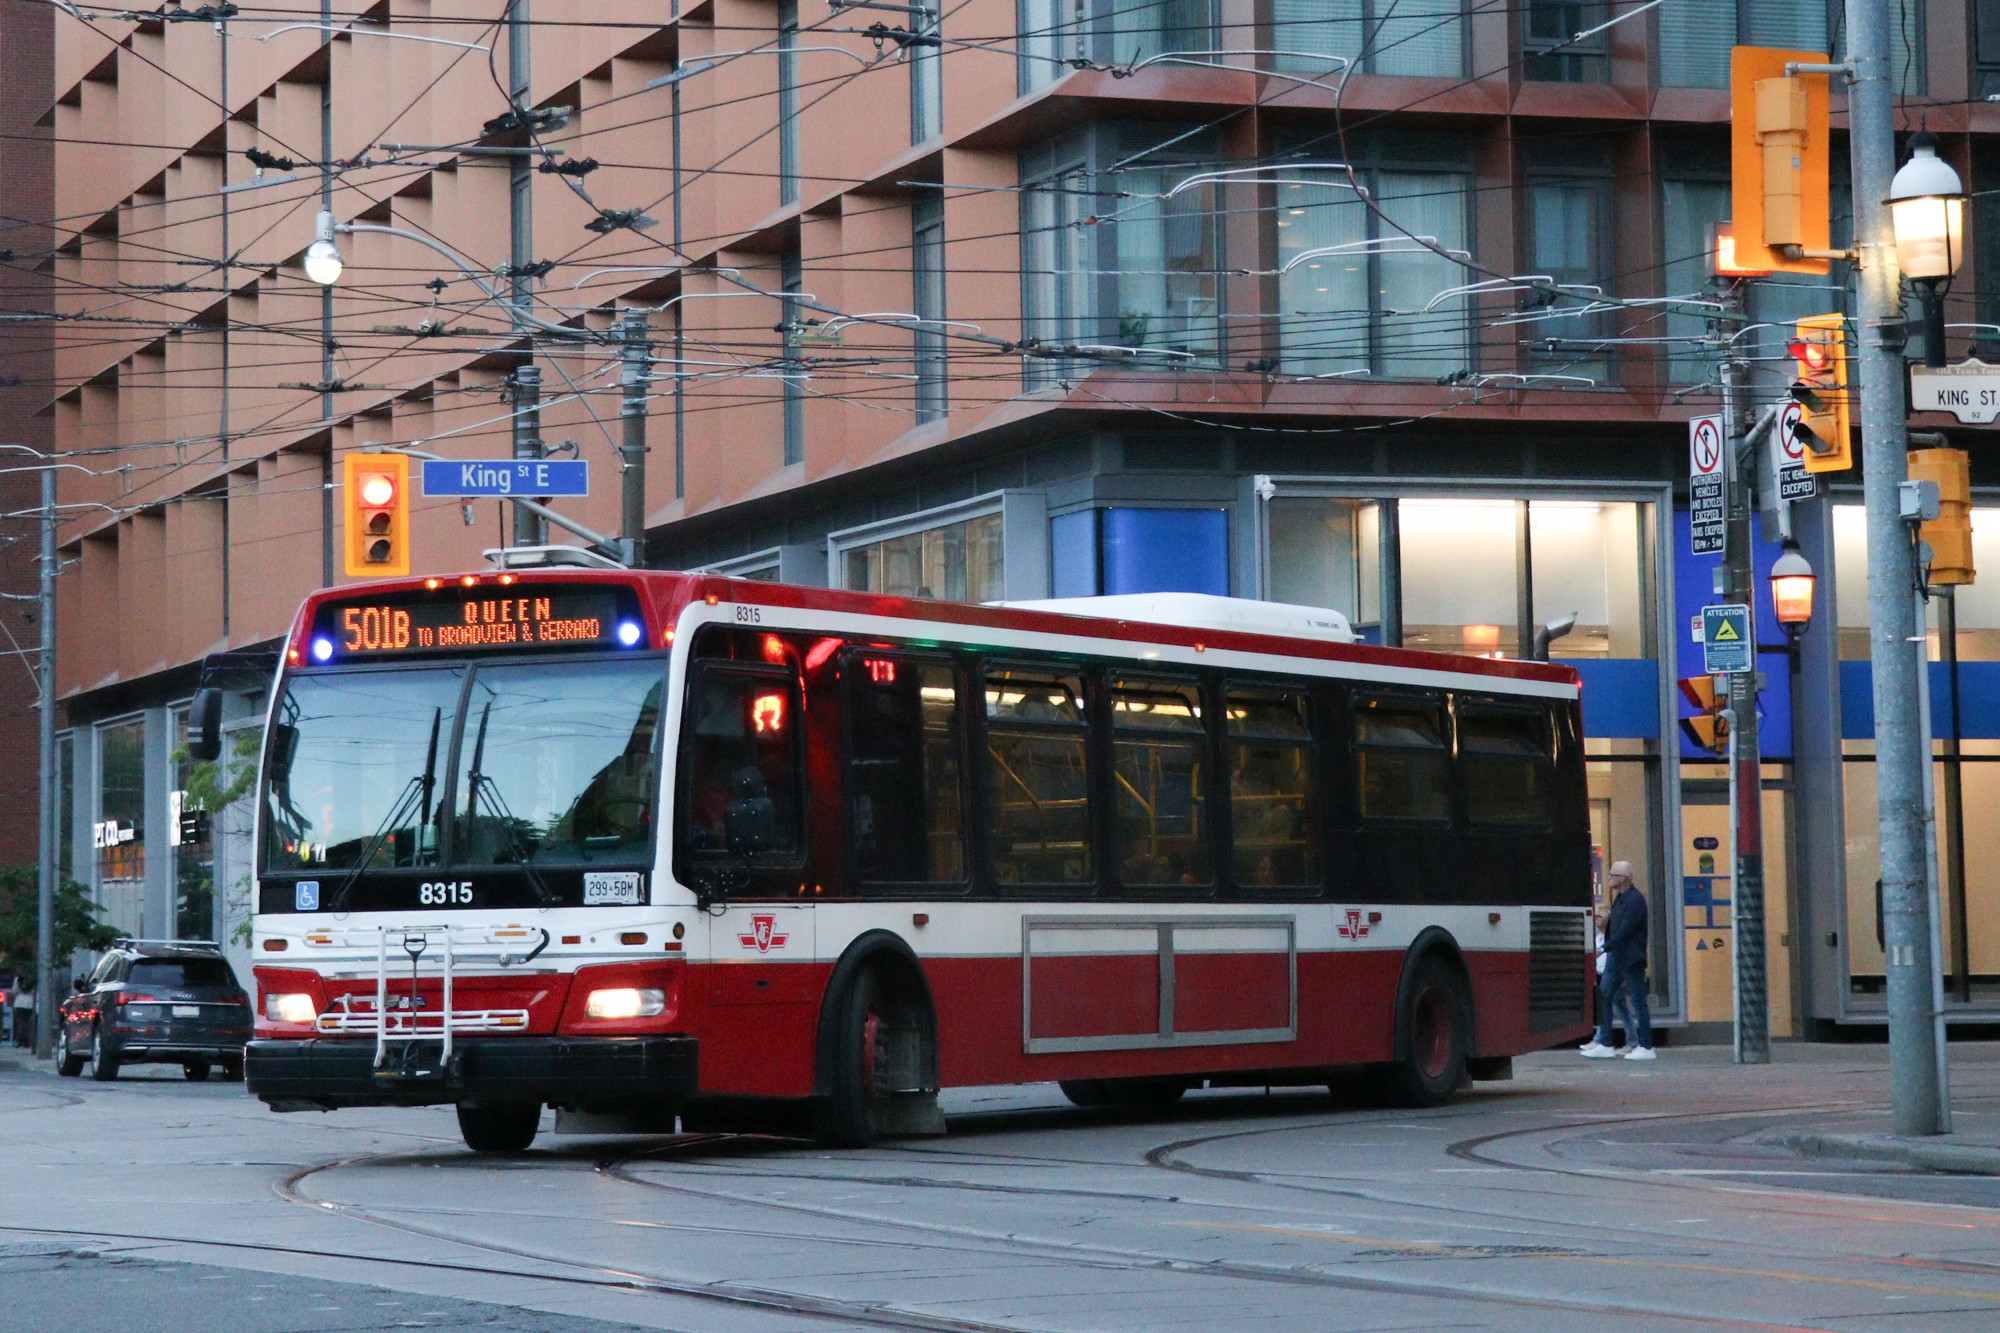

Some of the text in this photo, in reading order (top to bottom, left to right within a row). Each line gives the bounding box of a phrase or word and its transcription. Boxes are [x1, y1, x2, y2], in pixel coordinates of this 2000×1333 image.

[1937, 390, 1999, 406] KING ST.
[1971, 411, 1981, 419] 92
[461, 464, 550, 494] King St E
[1692, 474, 1721, 486] AUTHORIZED
[1780, 471, 1791, 482] TTC
[1695, 486, 1718, 497] VEHICLES
[1782, 481, 1813, 495] EXCEPTED
[1692, 497, 1722, 510] AND BICYCLES
[1695, 509, 1719, 521] EXCEPTED
[1705, 524, 1723, 536] EXCEPTED
[464, 598, 550, 624] QUEEN
[736, 606, 761, 623] 8315
[1707, 608, 1744, 617] ATTENTION
[344, 607, 410, 650] 501B
[417, 618, 600, 647] TO BROADVIEW & GERRARD
[420, 882, 473, 904] 8315
